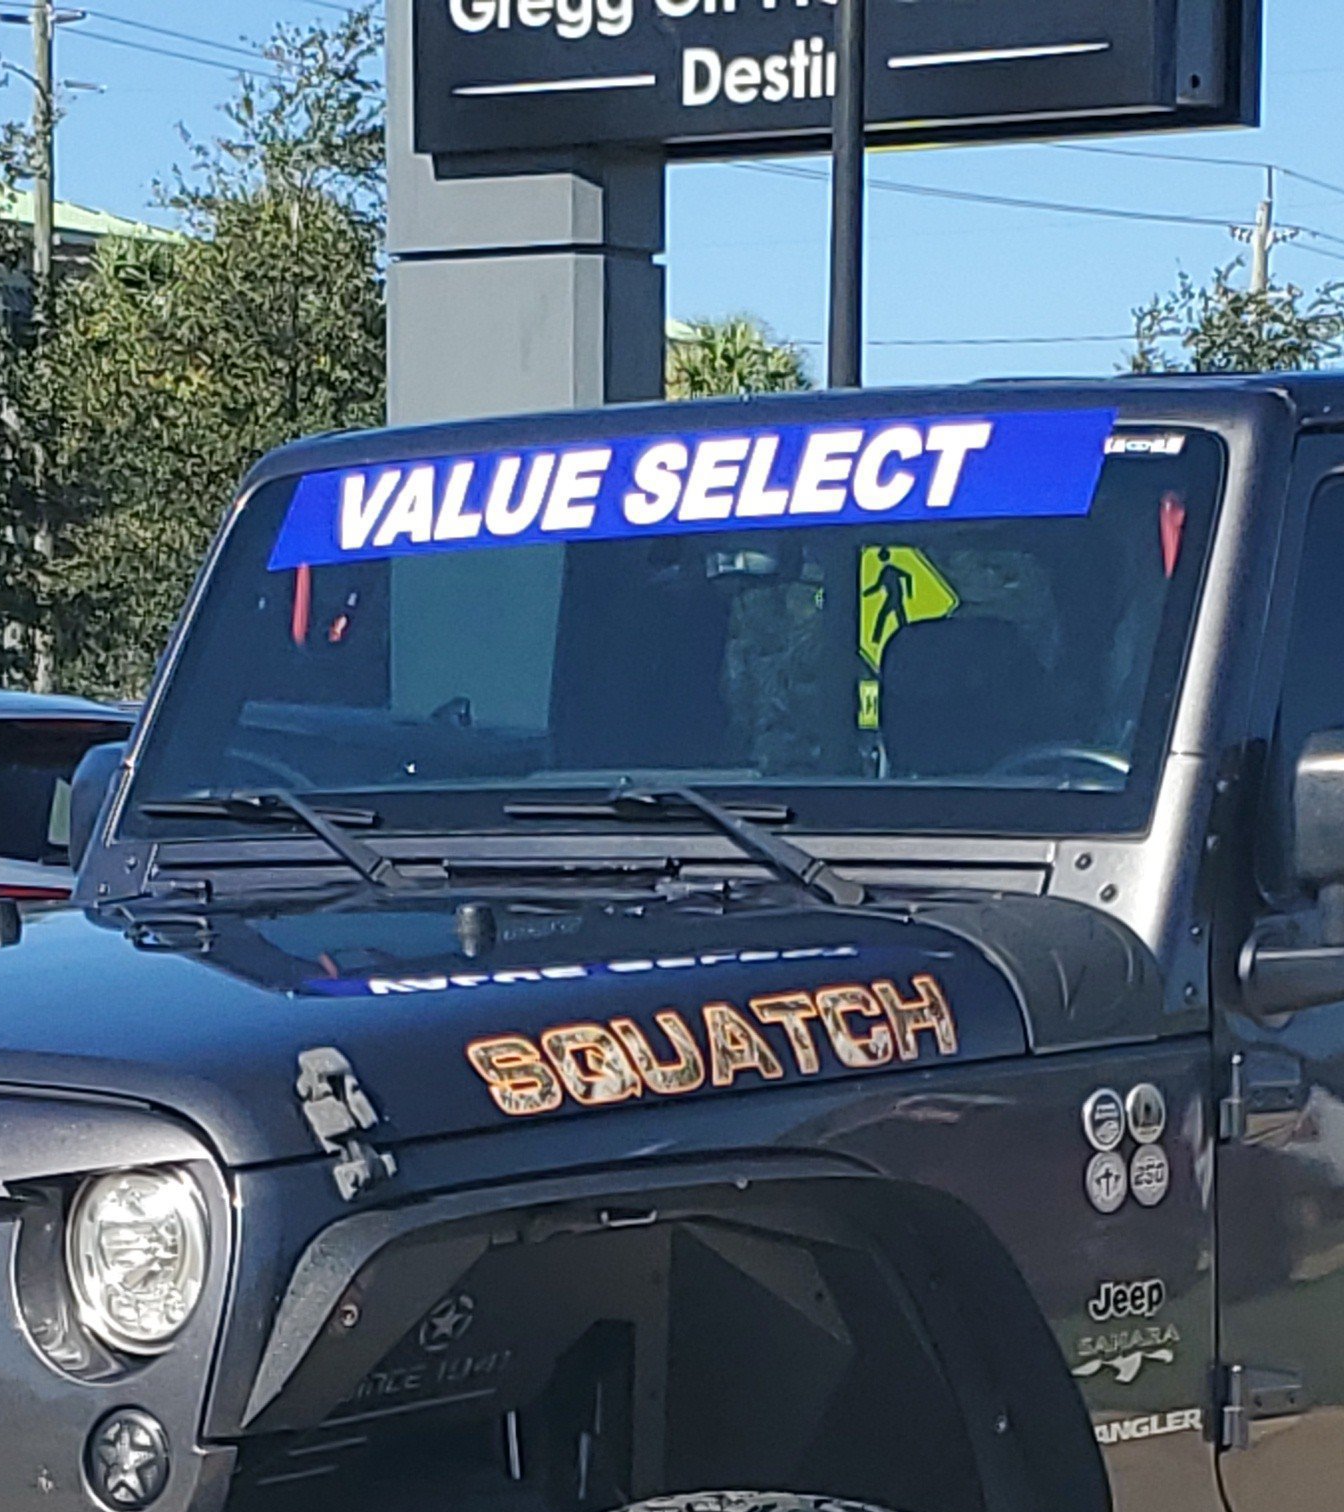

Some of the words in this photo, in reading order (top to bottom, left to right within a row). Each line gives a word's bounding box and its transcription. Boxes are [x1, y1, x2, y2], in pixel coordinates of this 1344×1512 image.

[340, 449, 612, 551] VALUE
[623, 422, 990, 522] SELECT
[467, 975, 959, 1116] SQUATCH
[1088, 1280, 1164, 1320] Jeep
[1094, 1408, 1204, 1443] ANGLER
